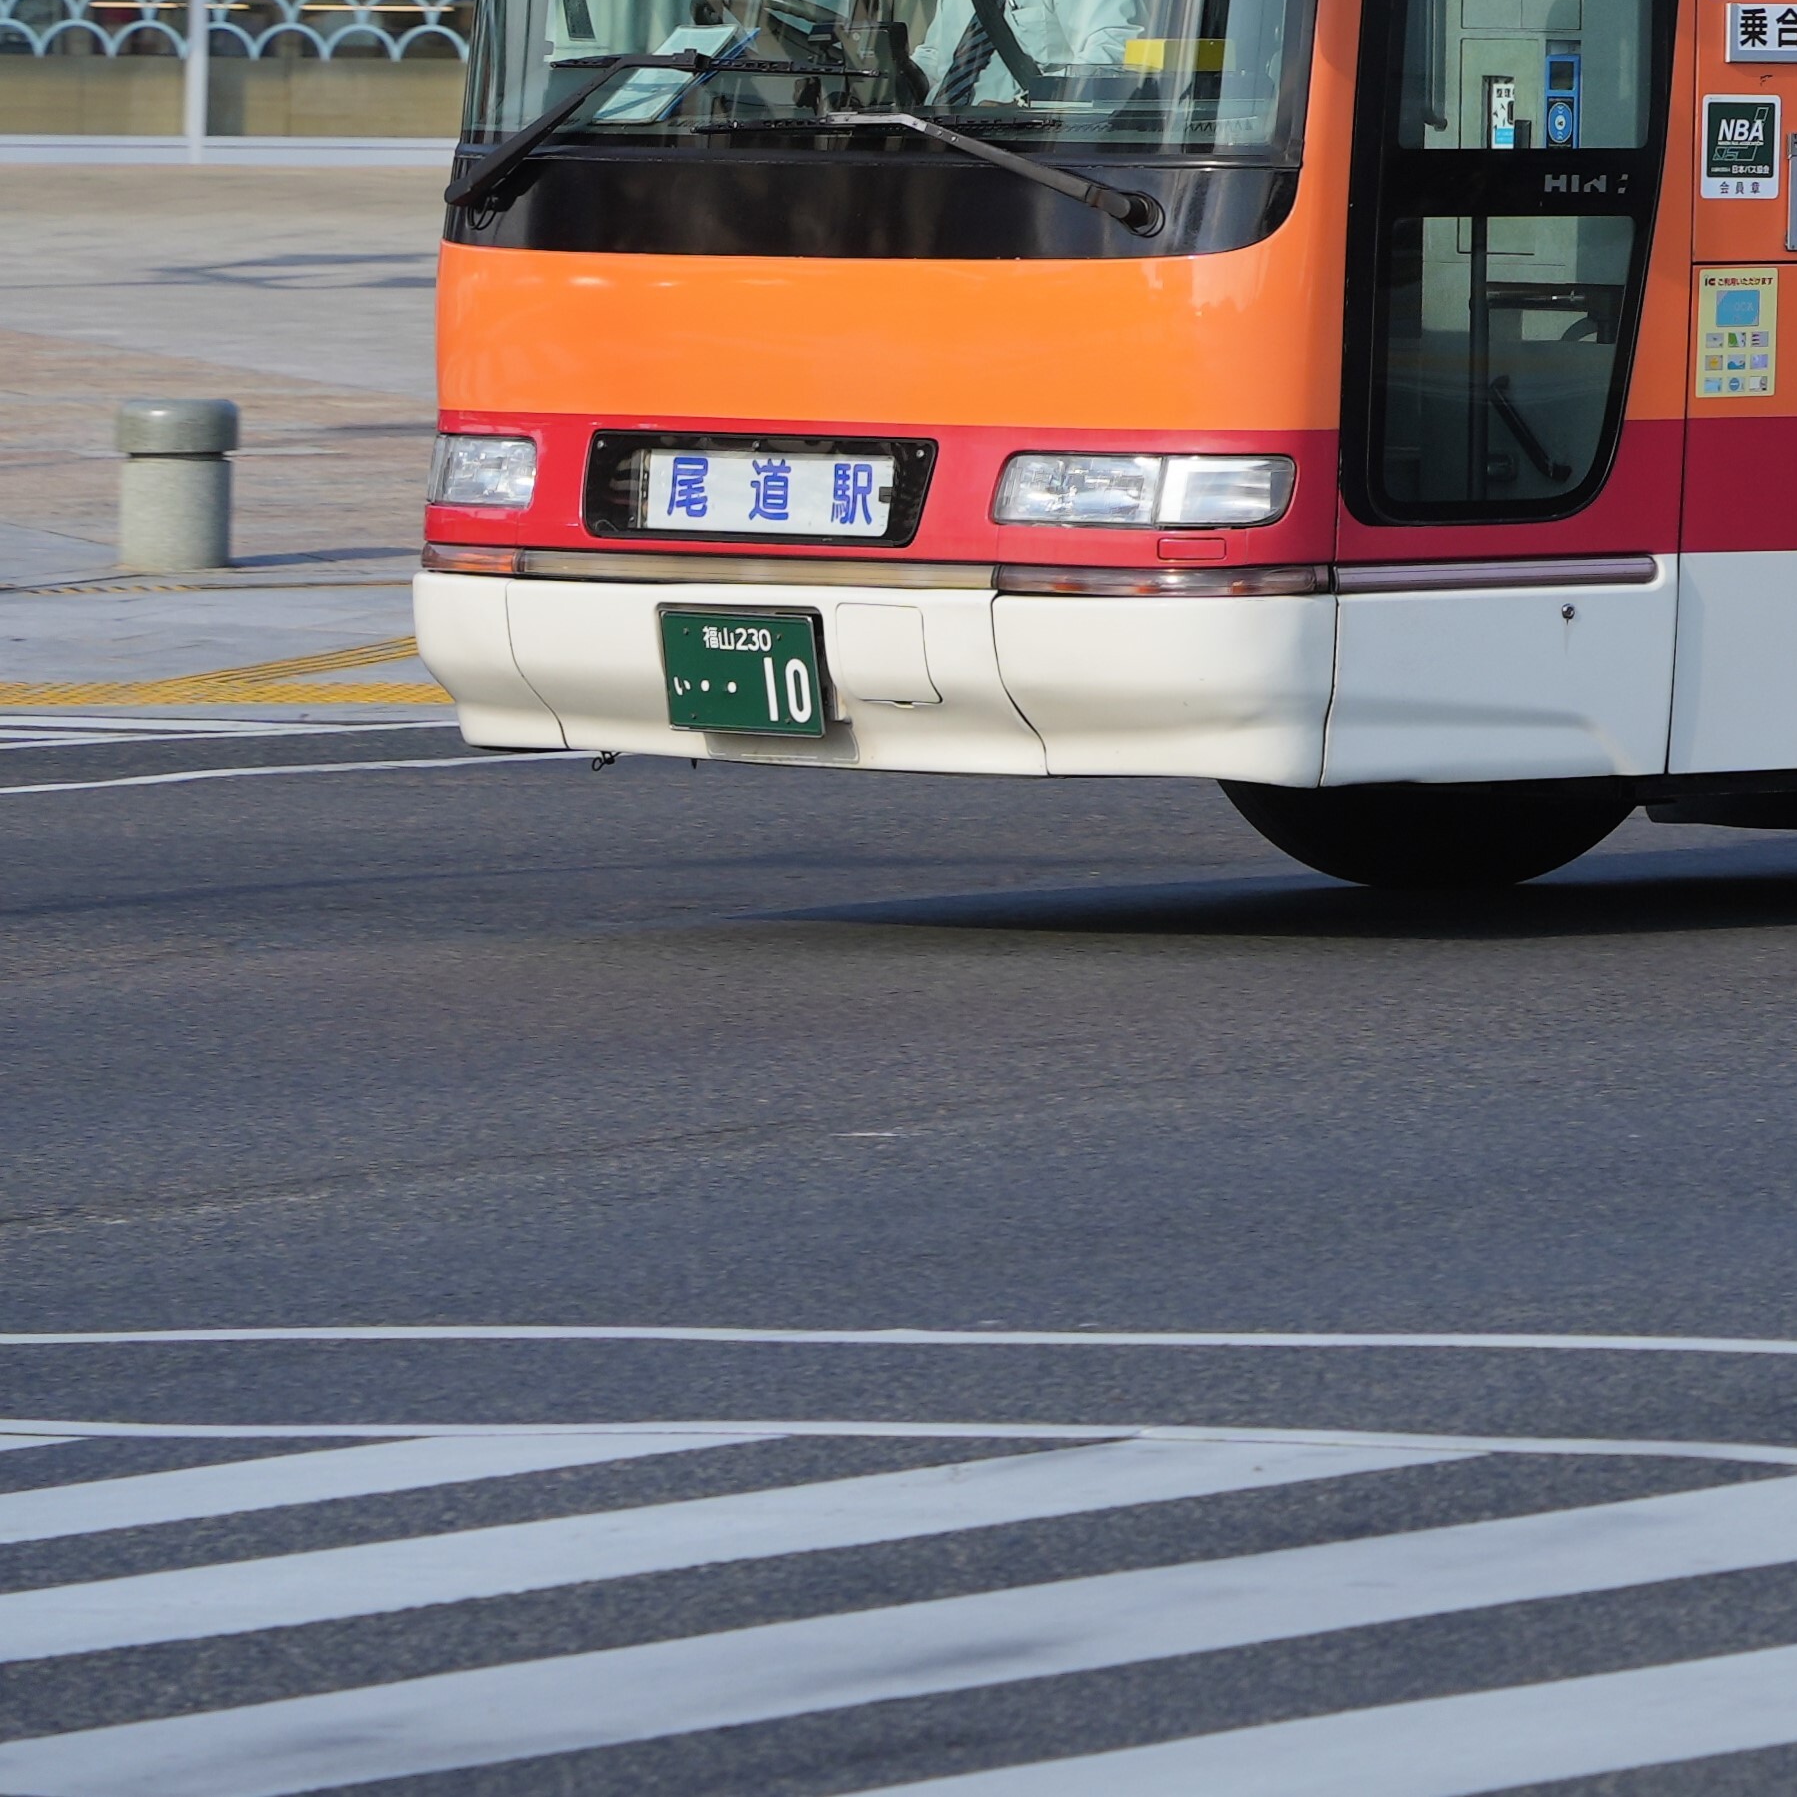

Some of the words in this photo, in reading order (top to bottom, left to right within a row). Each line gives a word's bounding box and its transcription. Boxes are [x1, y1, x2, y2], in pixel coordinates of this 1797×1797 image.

[1717, 118, 1764, 141] NBA
[666, 456, 873, 525] 尾道駅
